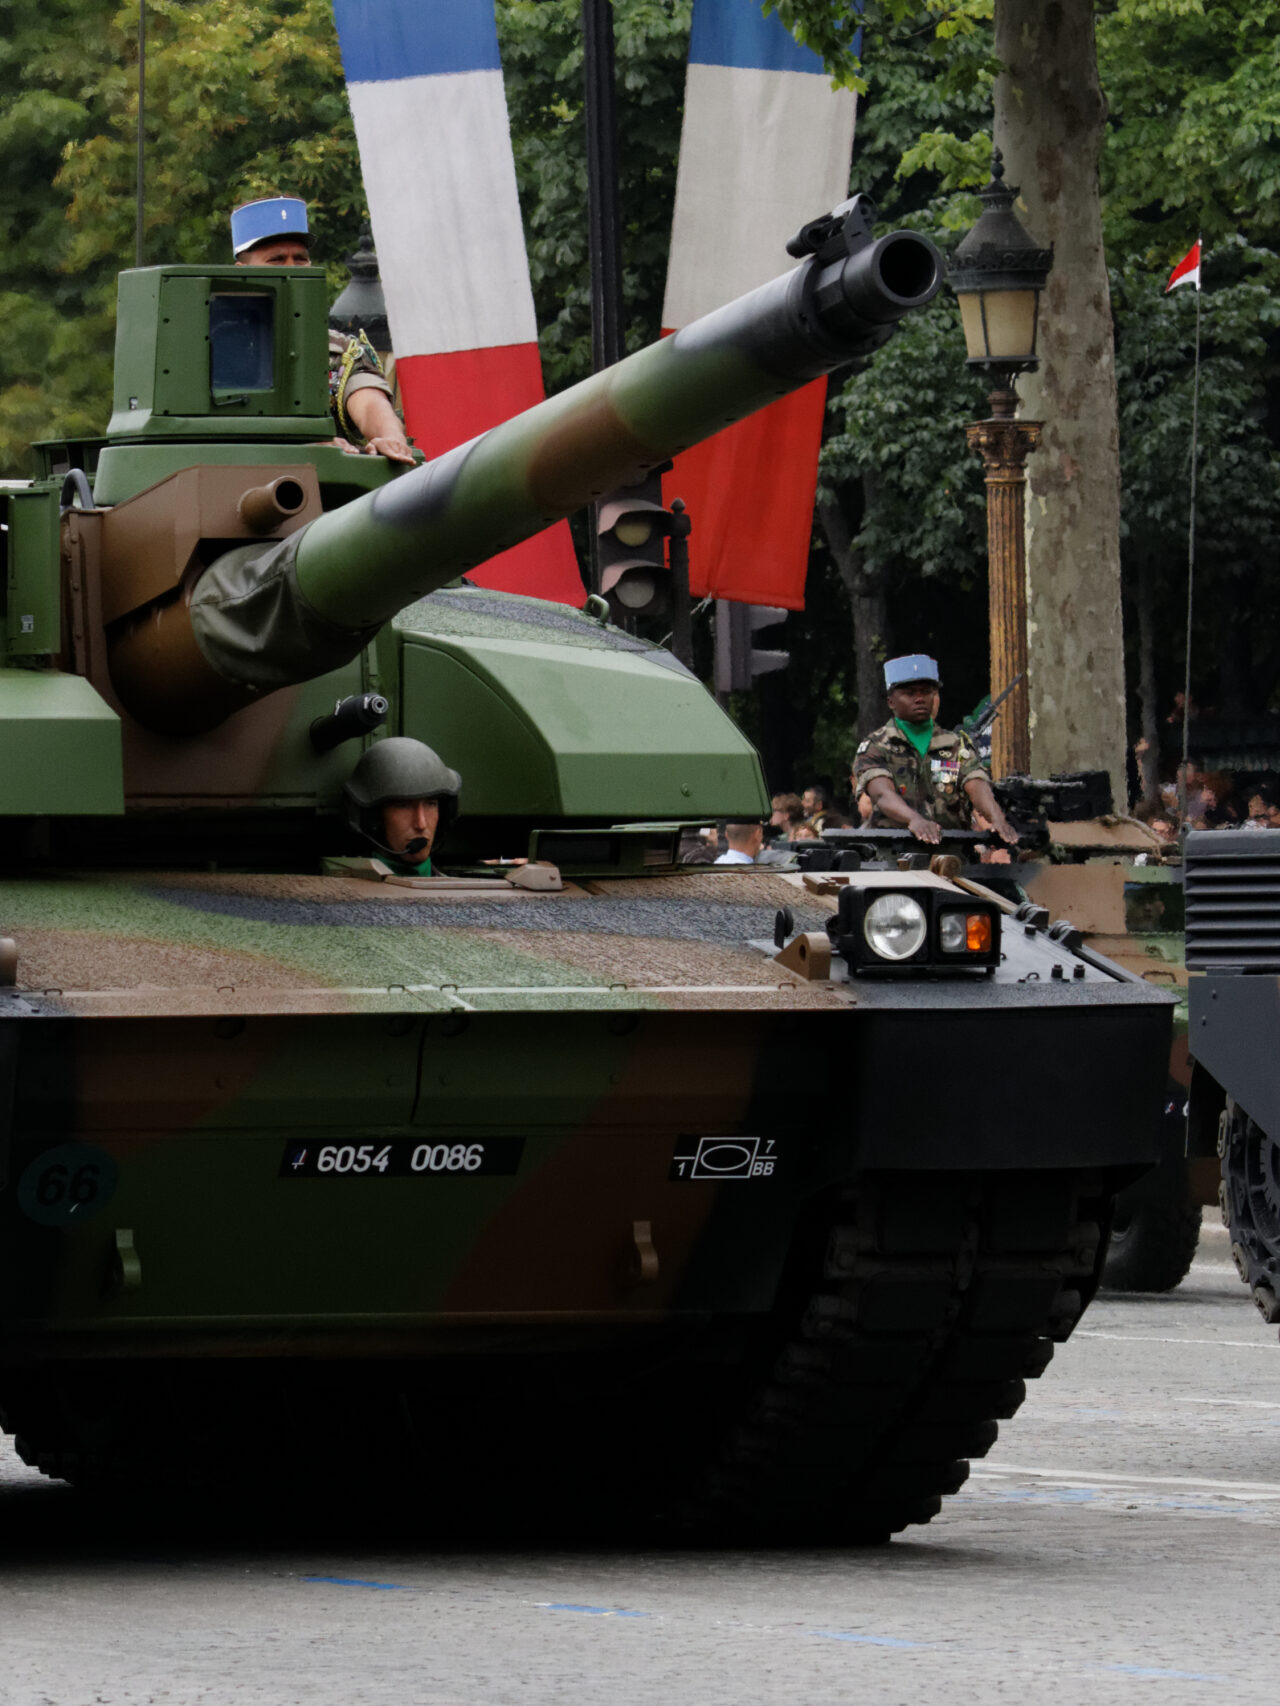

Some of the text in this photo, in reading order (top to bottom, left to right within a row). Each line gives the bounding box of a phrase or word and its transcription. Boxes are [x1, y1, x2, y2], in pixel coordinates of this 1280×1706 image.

[765, 1140, 776, 1153] 7
[317, 1144, 484, 1172] 6054 0086
[678, 1162, 686, 1176] 1
[752, 1161, 775, 1176] BB
[36, 1164, 100, 1206] 66
